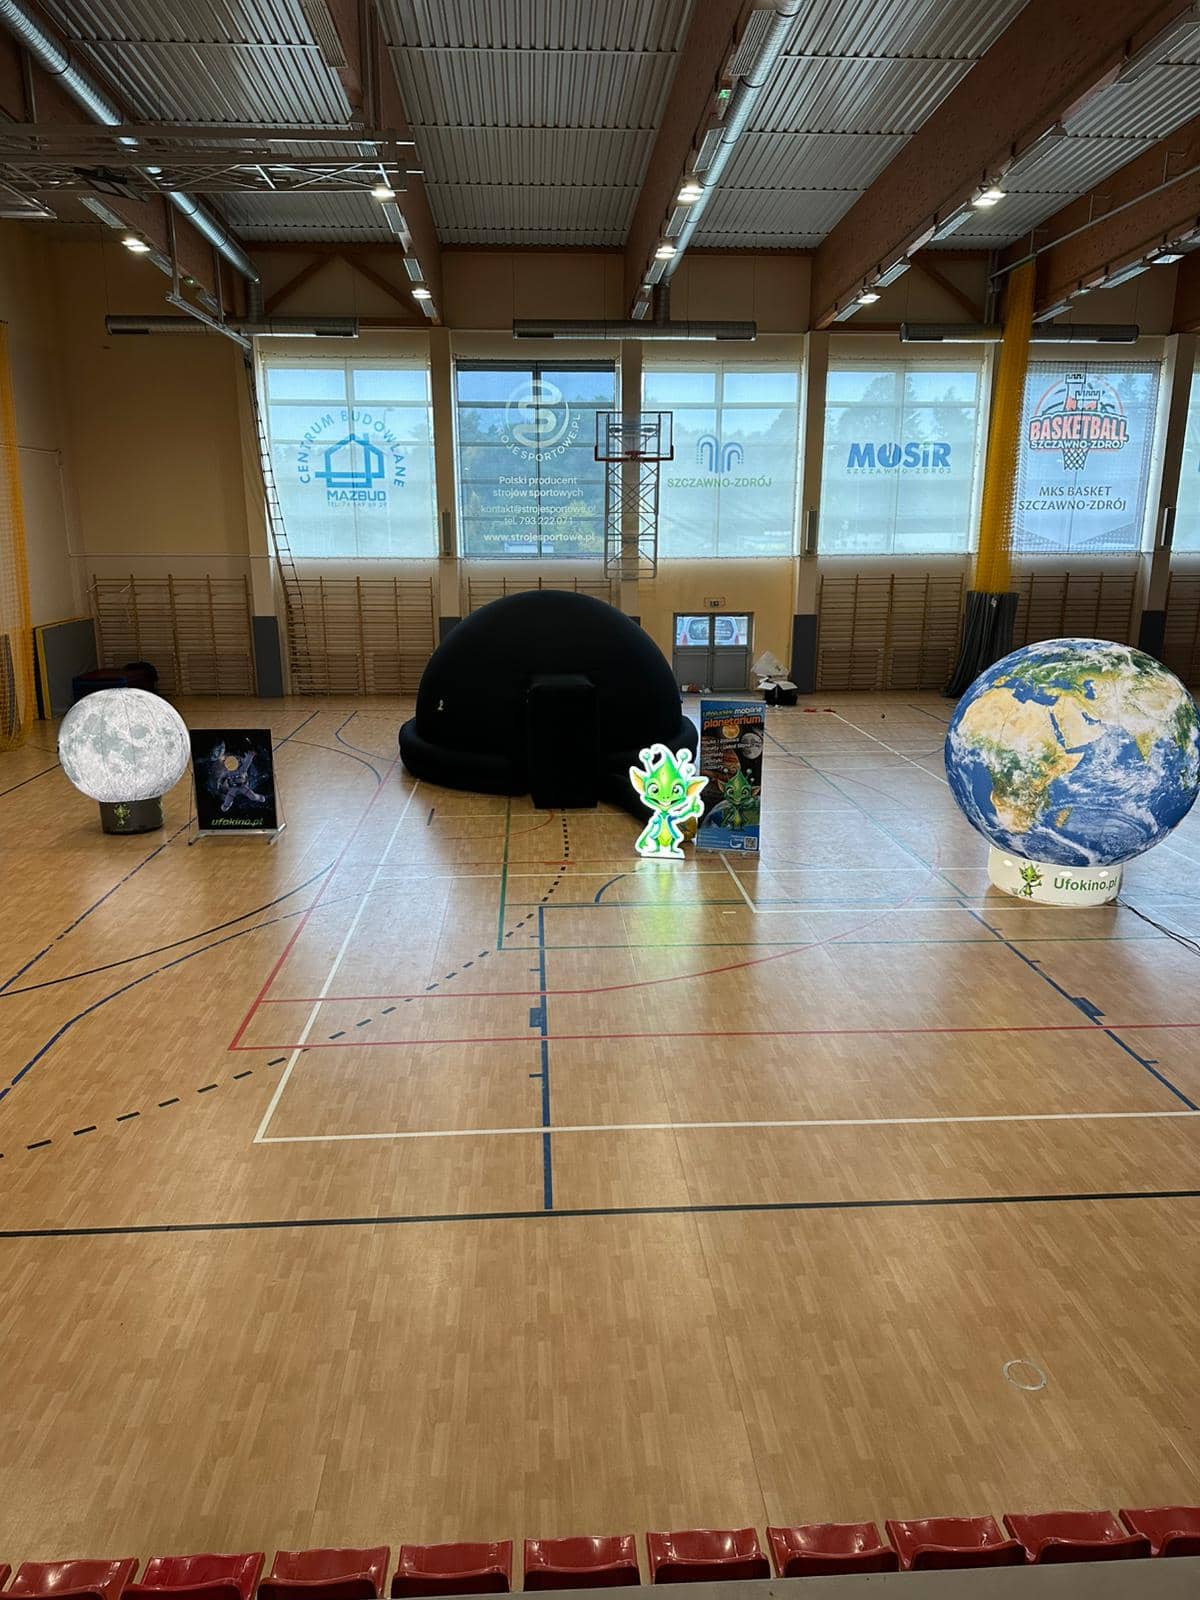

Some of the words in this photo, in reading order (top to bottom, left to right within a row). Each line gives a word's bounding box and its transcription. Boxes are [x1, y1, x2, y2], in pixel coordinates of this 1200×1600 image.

[1030, 415, 1128, 441] BASKETBALL
[520, 413, 581, 462] SPORTOWE.PL
[297, 413, 335, 484] CENTRUM
[340, 410, 407, 488] BUDOWLANE
[498, 475, 527, 485] Polski
[528, 476, 578, 487] producent
[667, 476, 772, 489] SZCZAWNO-ZDRÓJ
[326, 489, 387, 501] MAZBUD
[492, 488, 528, 499] strojów
[529, 488, 584, 499] sportowych
[1039, 487, 1065, 497] MKS
[1067, 487, 1112, 497] BASKET
[1018, 497, 1127, 511] SZCZAWNO-ZDRÓJ
[519, 517, 536, 525] 793
[537, 517, 555, 525] 222
[482, 532, 596, 543] www.strojesportowe.pl
[703, 715, 761, 730] planetarium
[211, 817, 264, 827] ufokino.pl
[1054, 876, 1117, 891] Ufokino.pl
